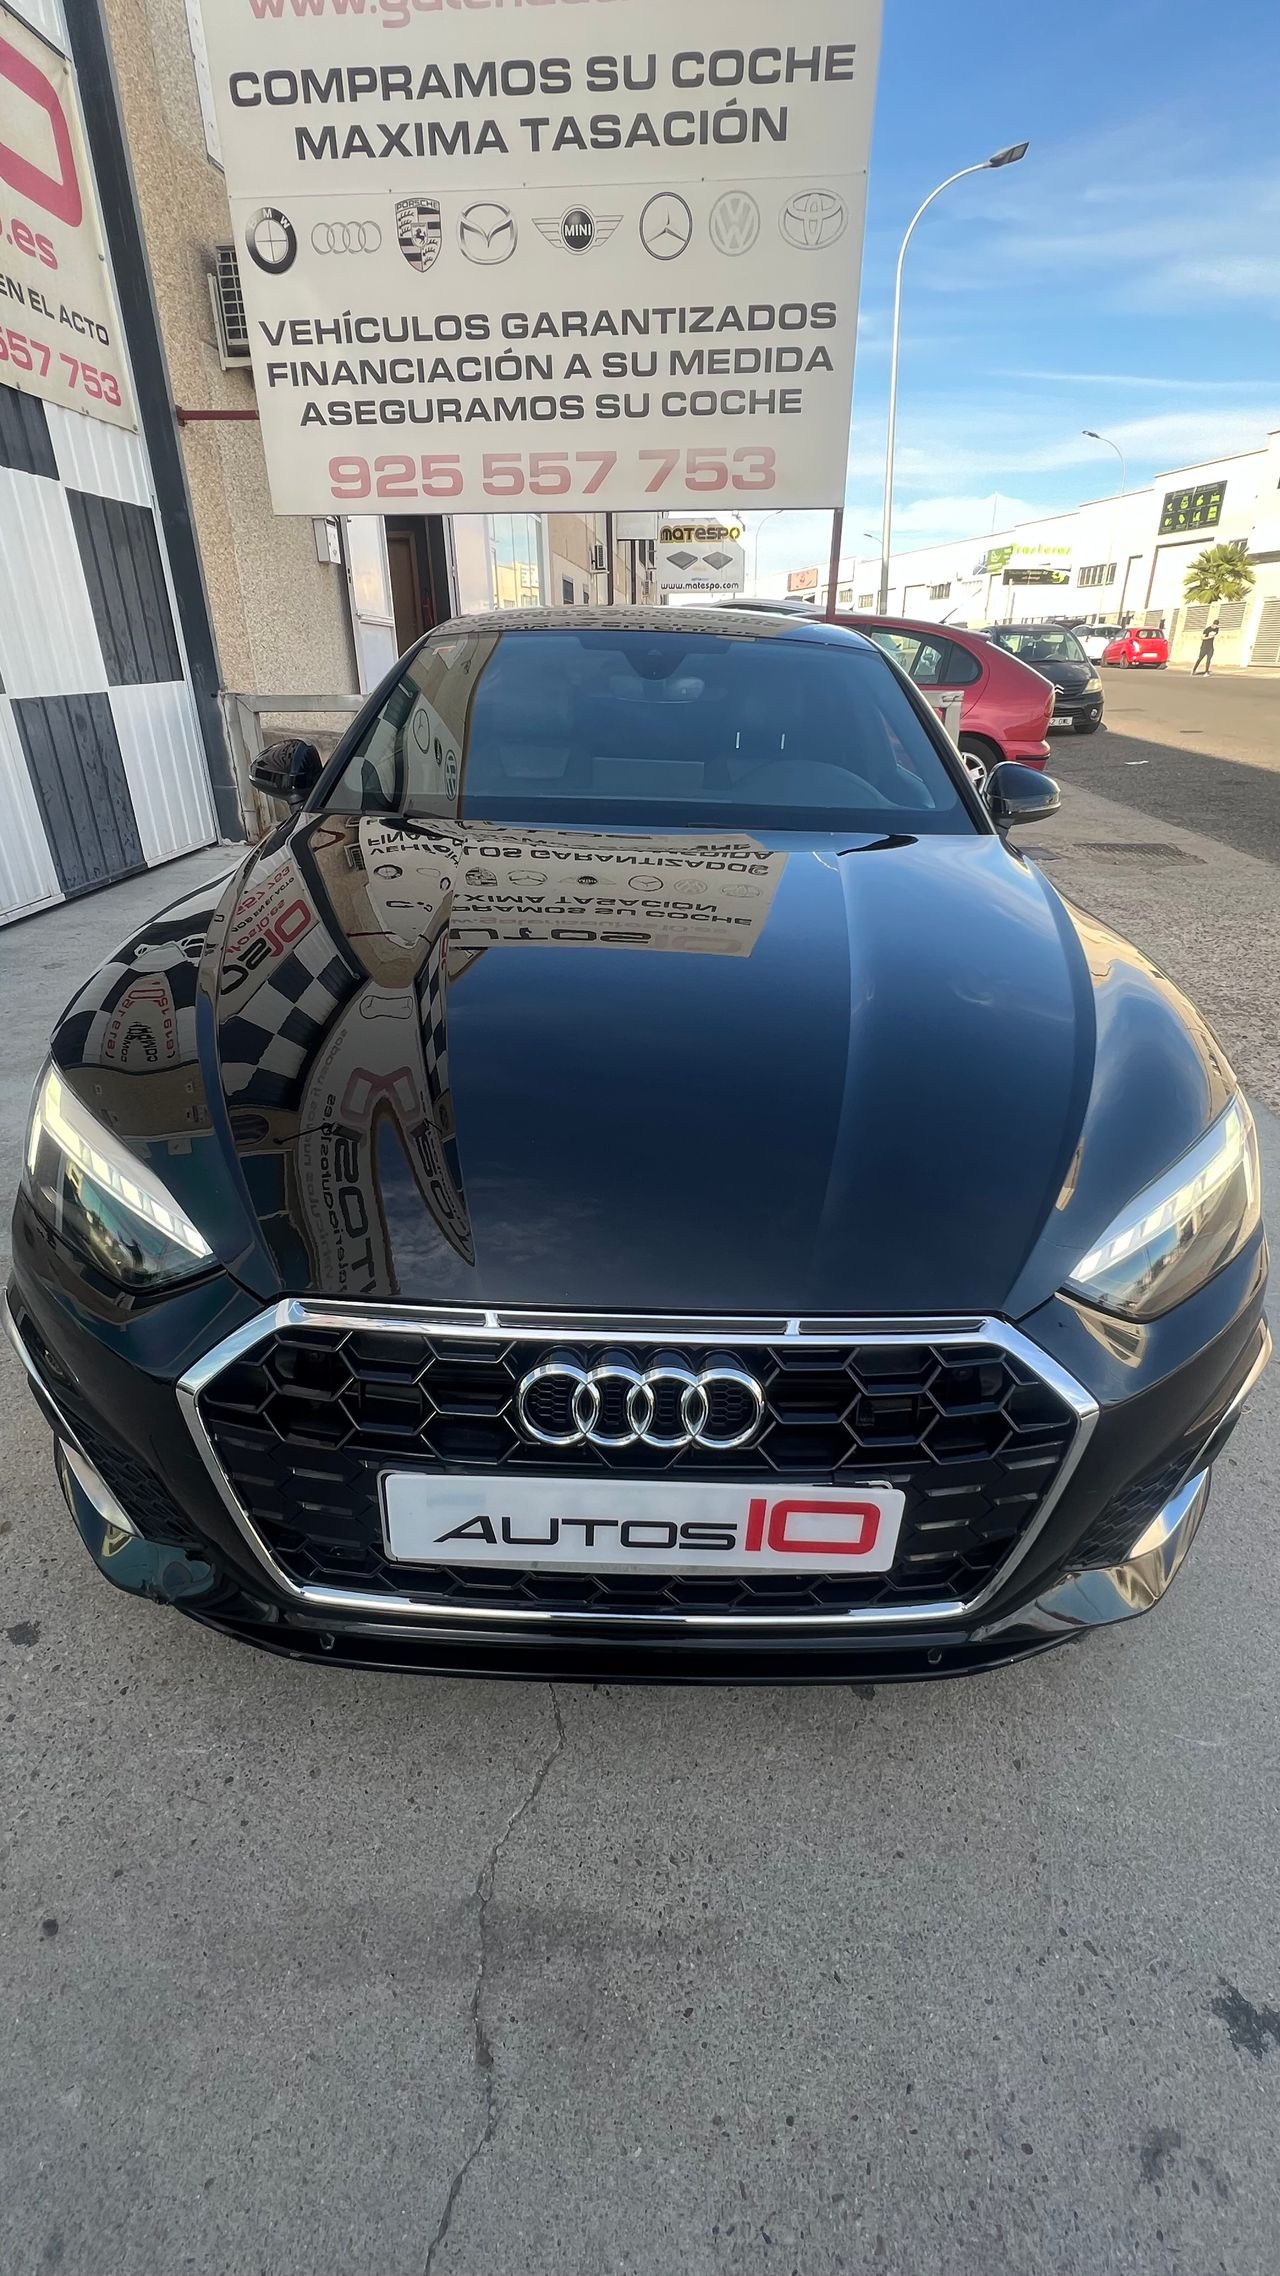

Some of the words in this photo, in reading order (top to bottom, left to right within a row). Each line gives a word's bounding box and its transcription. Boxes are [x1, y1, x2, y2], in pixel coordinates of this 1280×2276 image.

[229, 57, 572, 107] COMPRAMOS
[586, 54, 656, 92] SU
[672, 44, 857, 88] COCHE
[295, 120, 509, 160] MAXIMA
[520, 97, 788, 152] TASACIÓN
[564, 223, 592, 237] MINI
[28, 287, 55, 320] EL
[59, 304, 110, 346] ACTO
[259, 310, 491, 346] VEHÍCULOS
[501, 302, 837, 340] GARANTIZADOS
[59, 352, 121, 406] 753
[267, 347, 553, 387] FINANCIACIÓN
[563, 353, 592, 379] A
[602, 351, 657, 378] SU
[669, 346, 834, 376] MEDIDA
[300, 395, 585, 426] ASEGURAMOS
[596, 393, 650, 418] SU
[661, 388, 803, 416] COCHE
[329, 455, 464, 499] 925
[482, 451, 617, 496] 557
[638, 446, 776, 492] 753
[660, 581, 739, 592] www.matespo.com
[433, 1498, 881, 1554] AUTOS10
